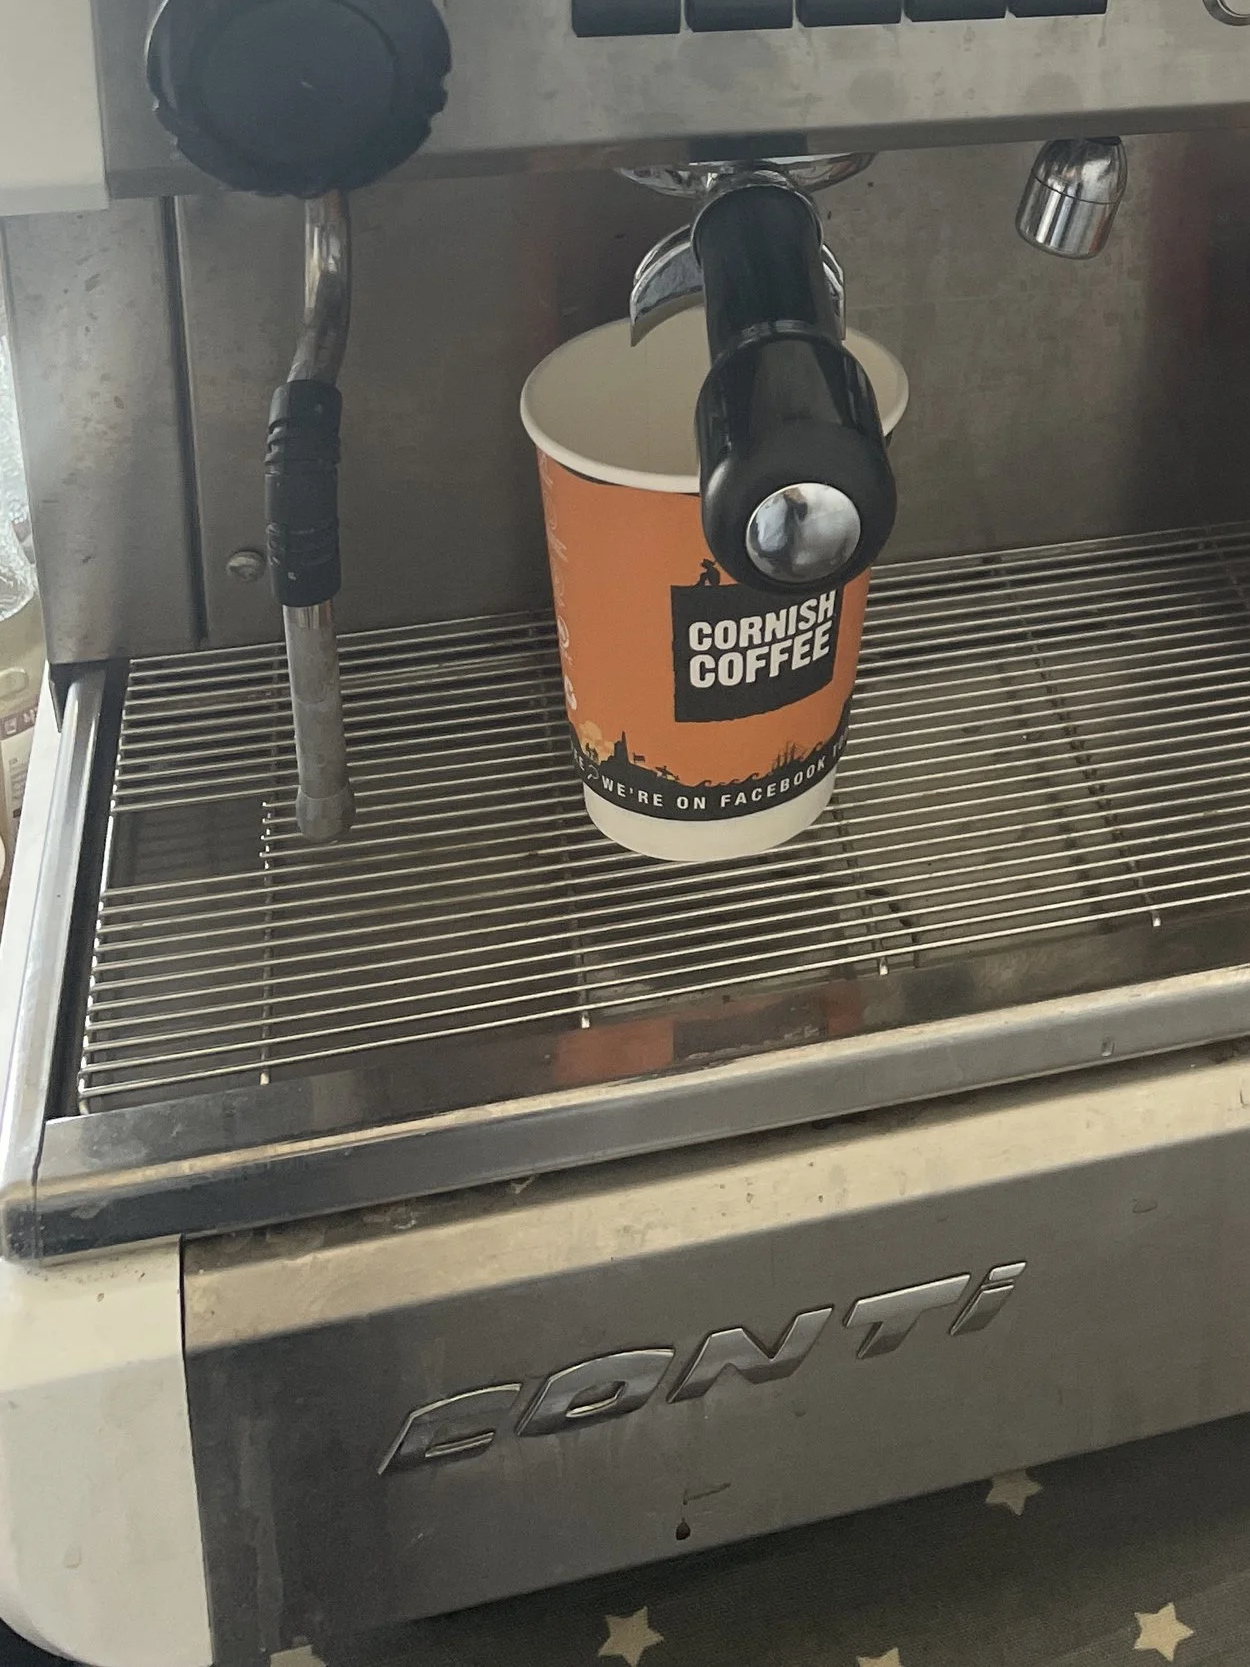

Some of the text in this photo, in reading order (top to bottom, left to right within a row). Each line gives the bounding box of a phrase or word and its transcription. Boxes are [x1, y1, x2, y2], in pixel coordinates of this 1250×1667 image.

[689, 590, 836, 651] CORNISH
[689, 621, 832, 688] COFFEE
[601, 775, 663, 807] WE'RE
[677, 796, 706, 809] ON
[720, 757, 826, 808] FACEBOOK
